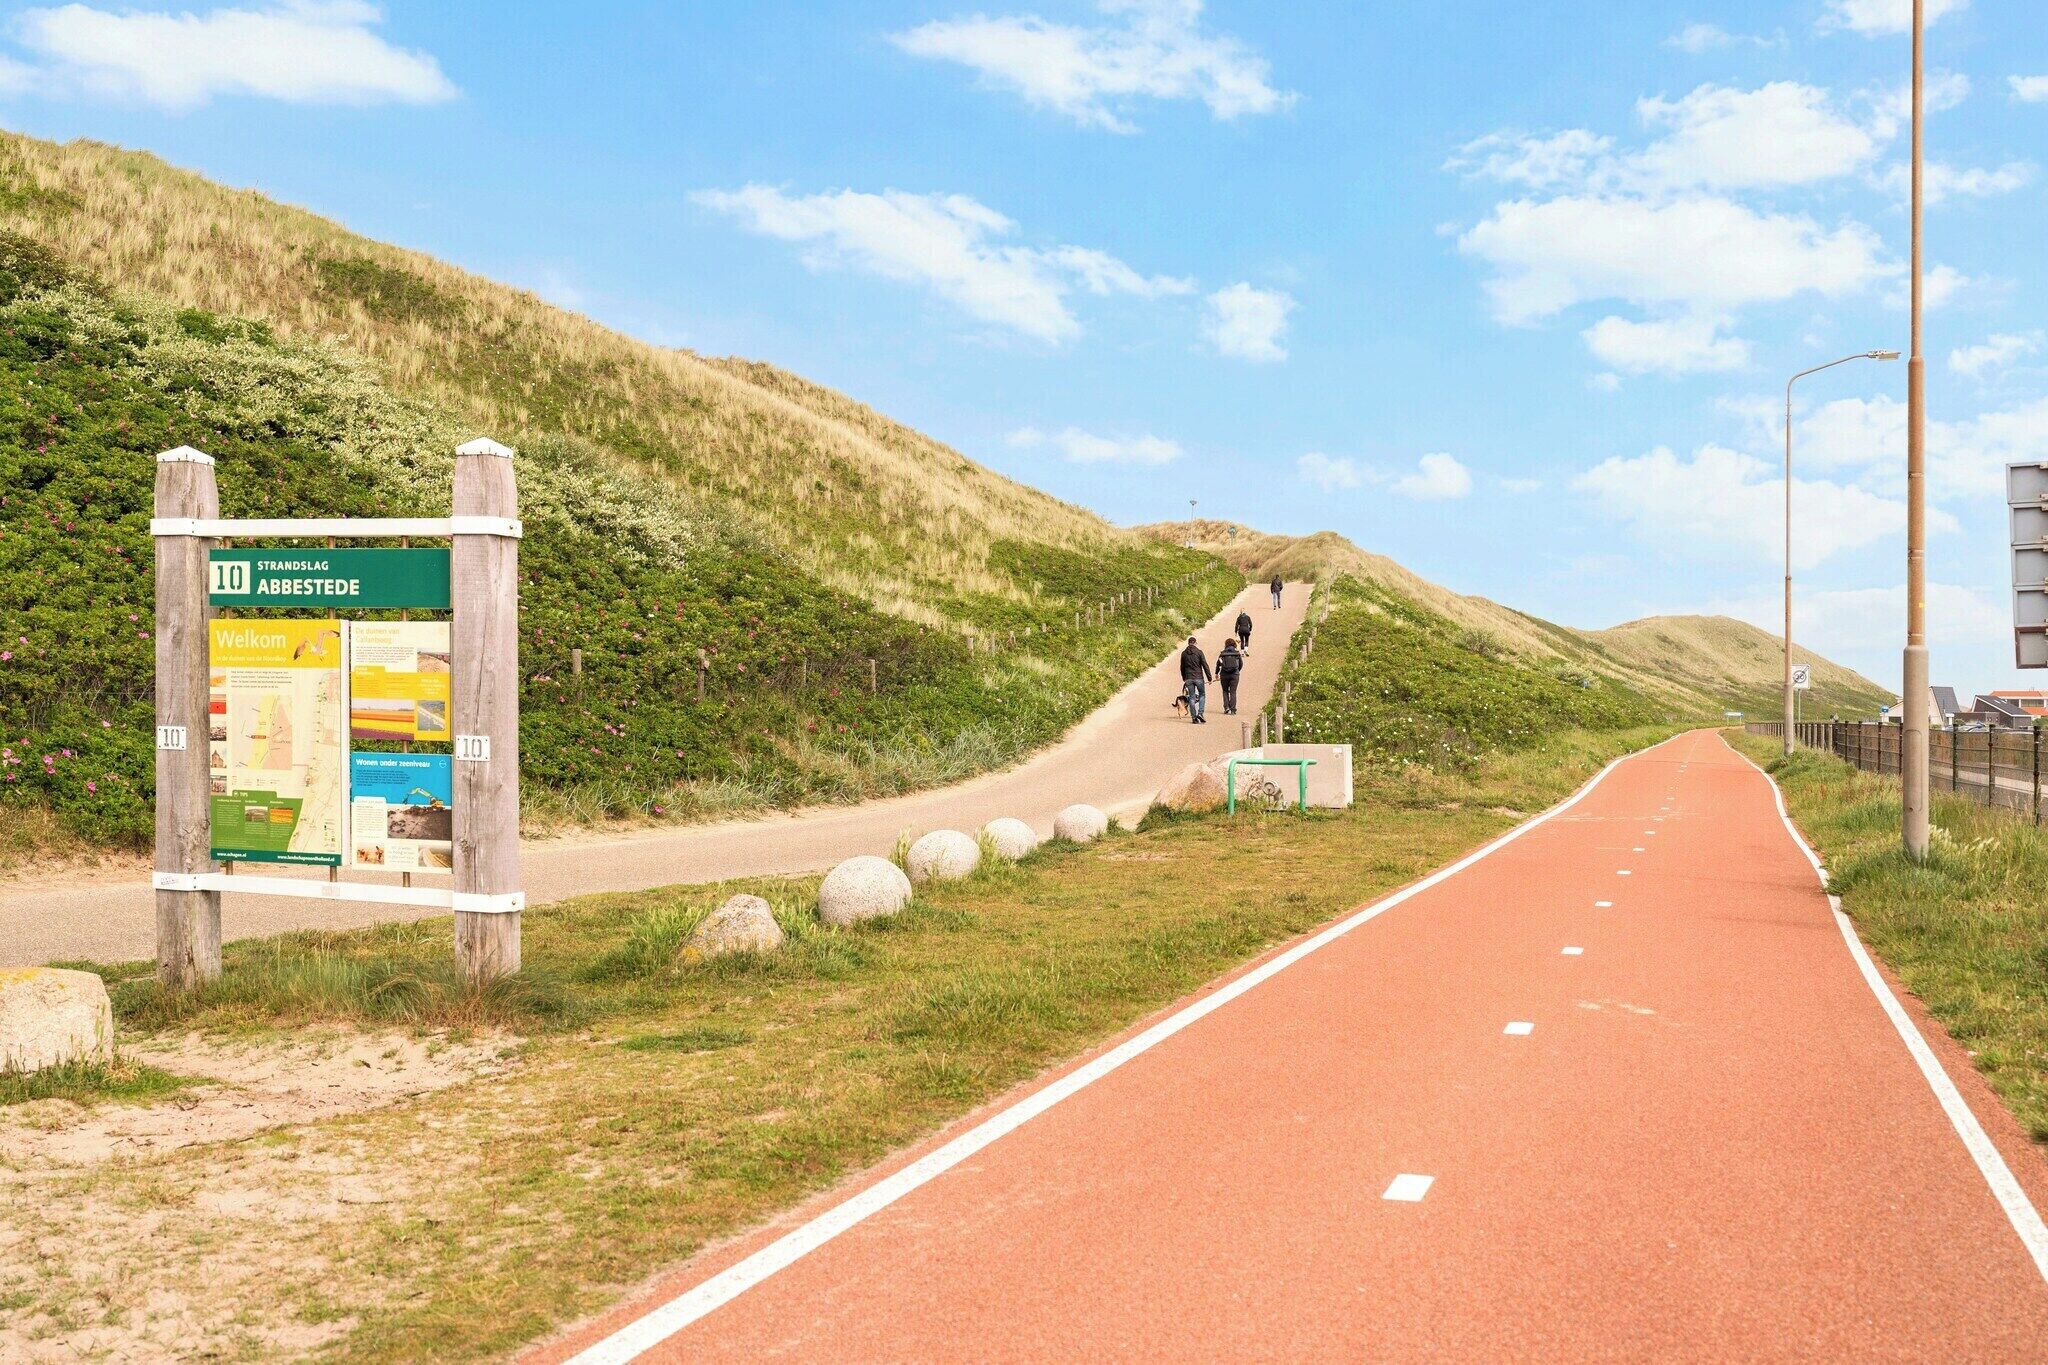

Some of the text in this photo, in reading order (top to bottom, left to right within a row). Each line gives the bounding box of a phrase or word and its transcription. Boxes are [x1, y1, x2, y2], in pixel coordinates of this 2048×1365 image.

[257, 560, 329, 571] STRANDSLAG
[217, 565, 243, 590] 10
[256, 579, 360, 596] ABBESTEDE
[216, 629, 287, 649] Welkom
[163, 728, 180, 748] 10
[463, 738, 482, 758] 10
[355, 758, 379, 766] Wonen
[379, 759, 398, 767] onder
